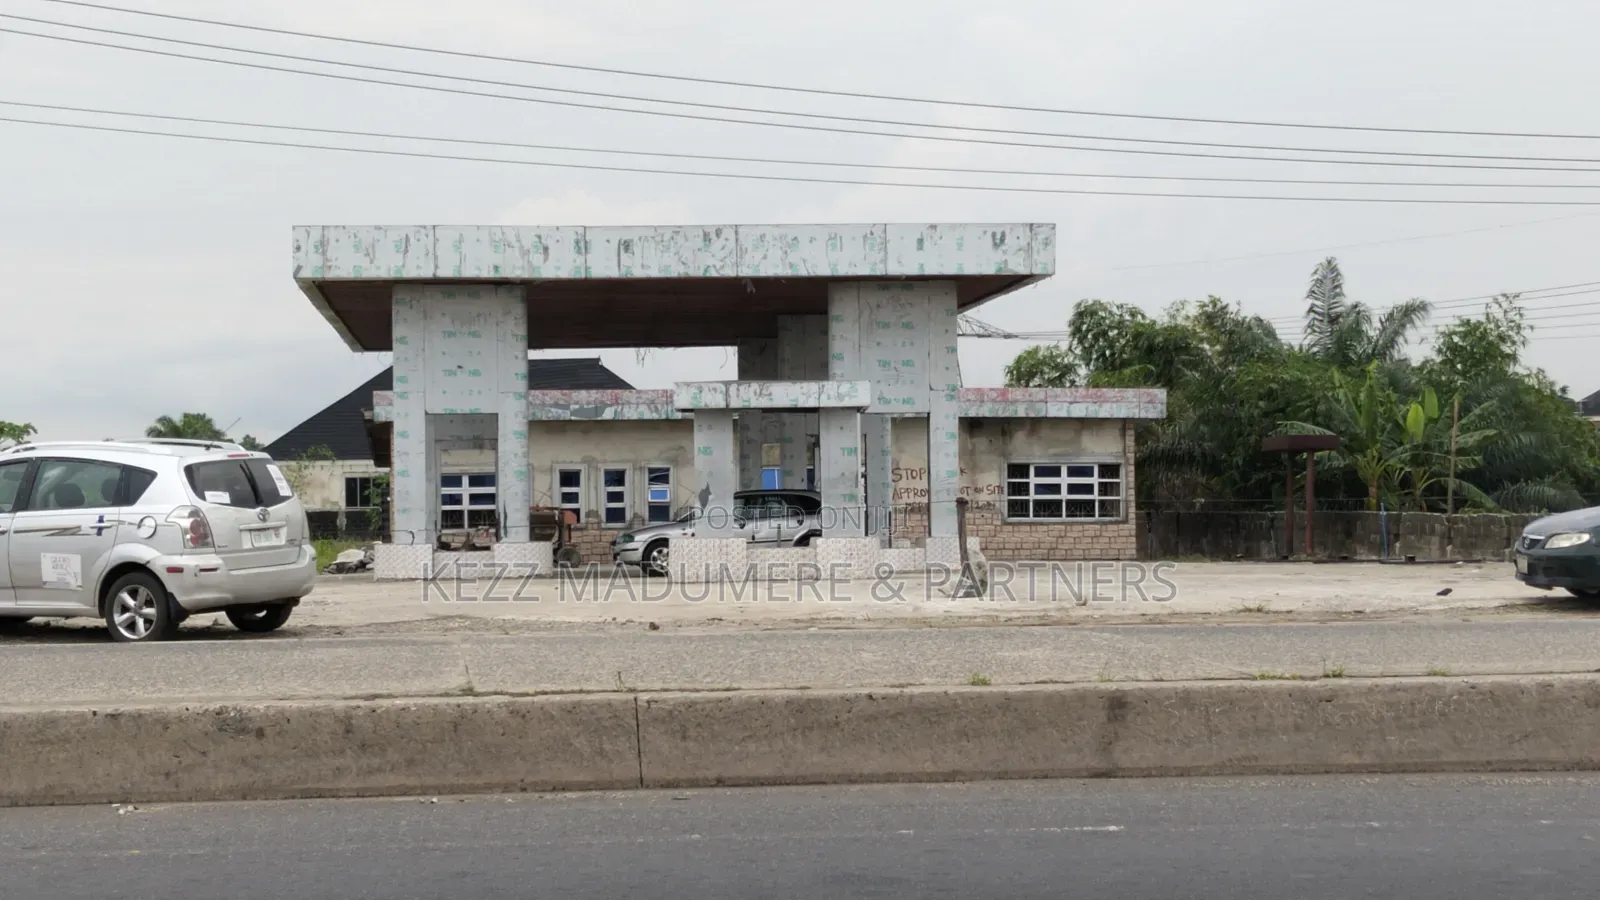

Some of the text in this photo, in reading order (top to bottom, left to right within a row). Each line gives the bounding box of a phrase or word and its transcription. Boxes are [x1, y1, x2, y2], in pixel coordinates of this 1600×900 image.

[892, 467, 926, 482] STOP
[892, 487, 929, 500] APPROV
[985, 484, 1005, 496] SITE
